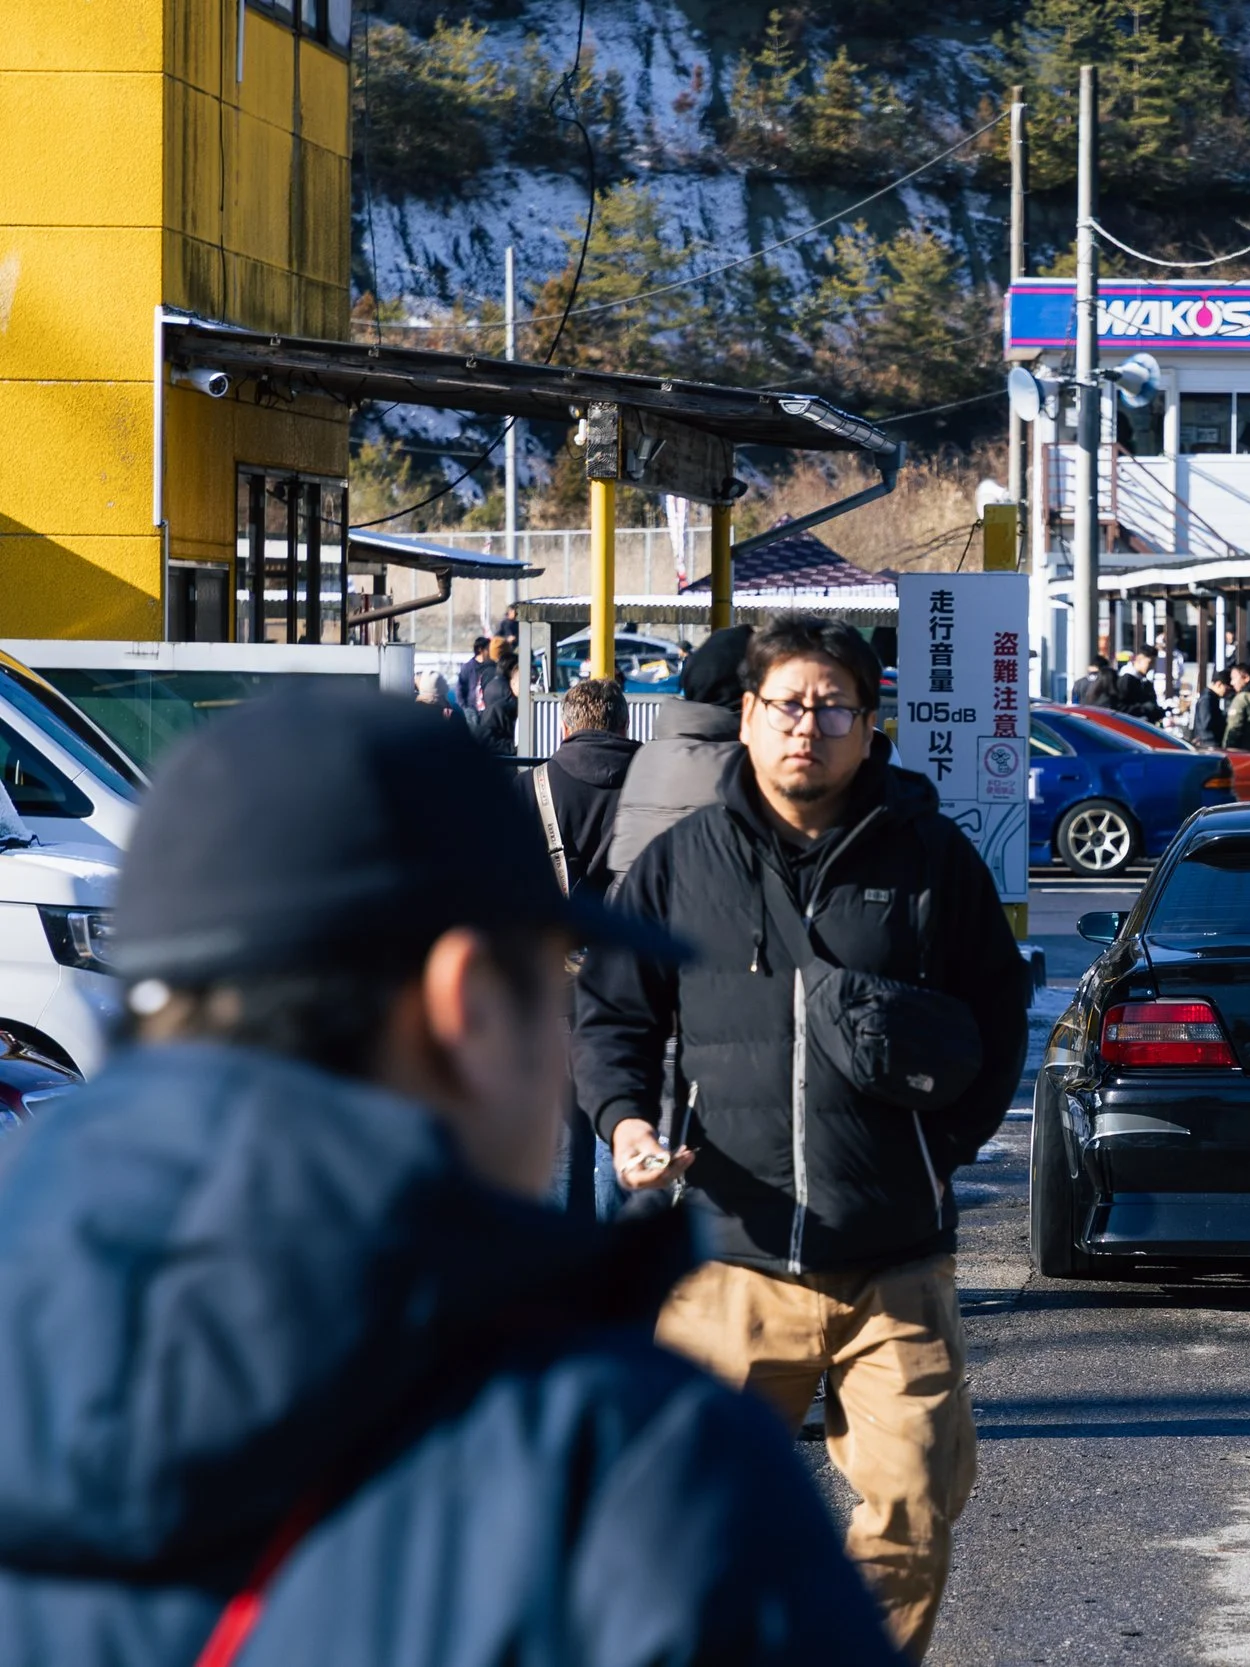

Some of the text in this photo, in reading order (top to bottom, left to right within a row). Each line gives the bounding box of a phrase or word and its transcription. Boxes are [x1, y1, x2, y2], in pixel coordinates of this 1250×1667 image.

[929, 589, 955, 693] 走行音量
[907, 702, 977, 722] 105dB
[993, 631, 1019, 737] 盗難注意
[928, 730, 954, 781] 以下
